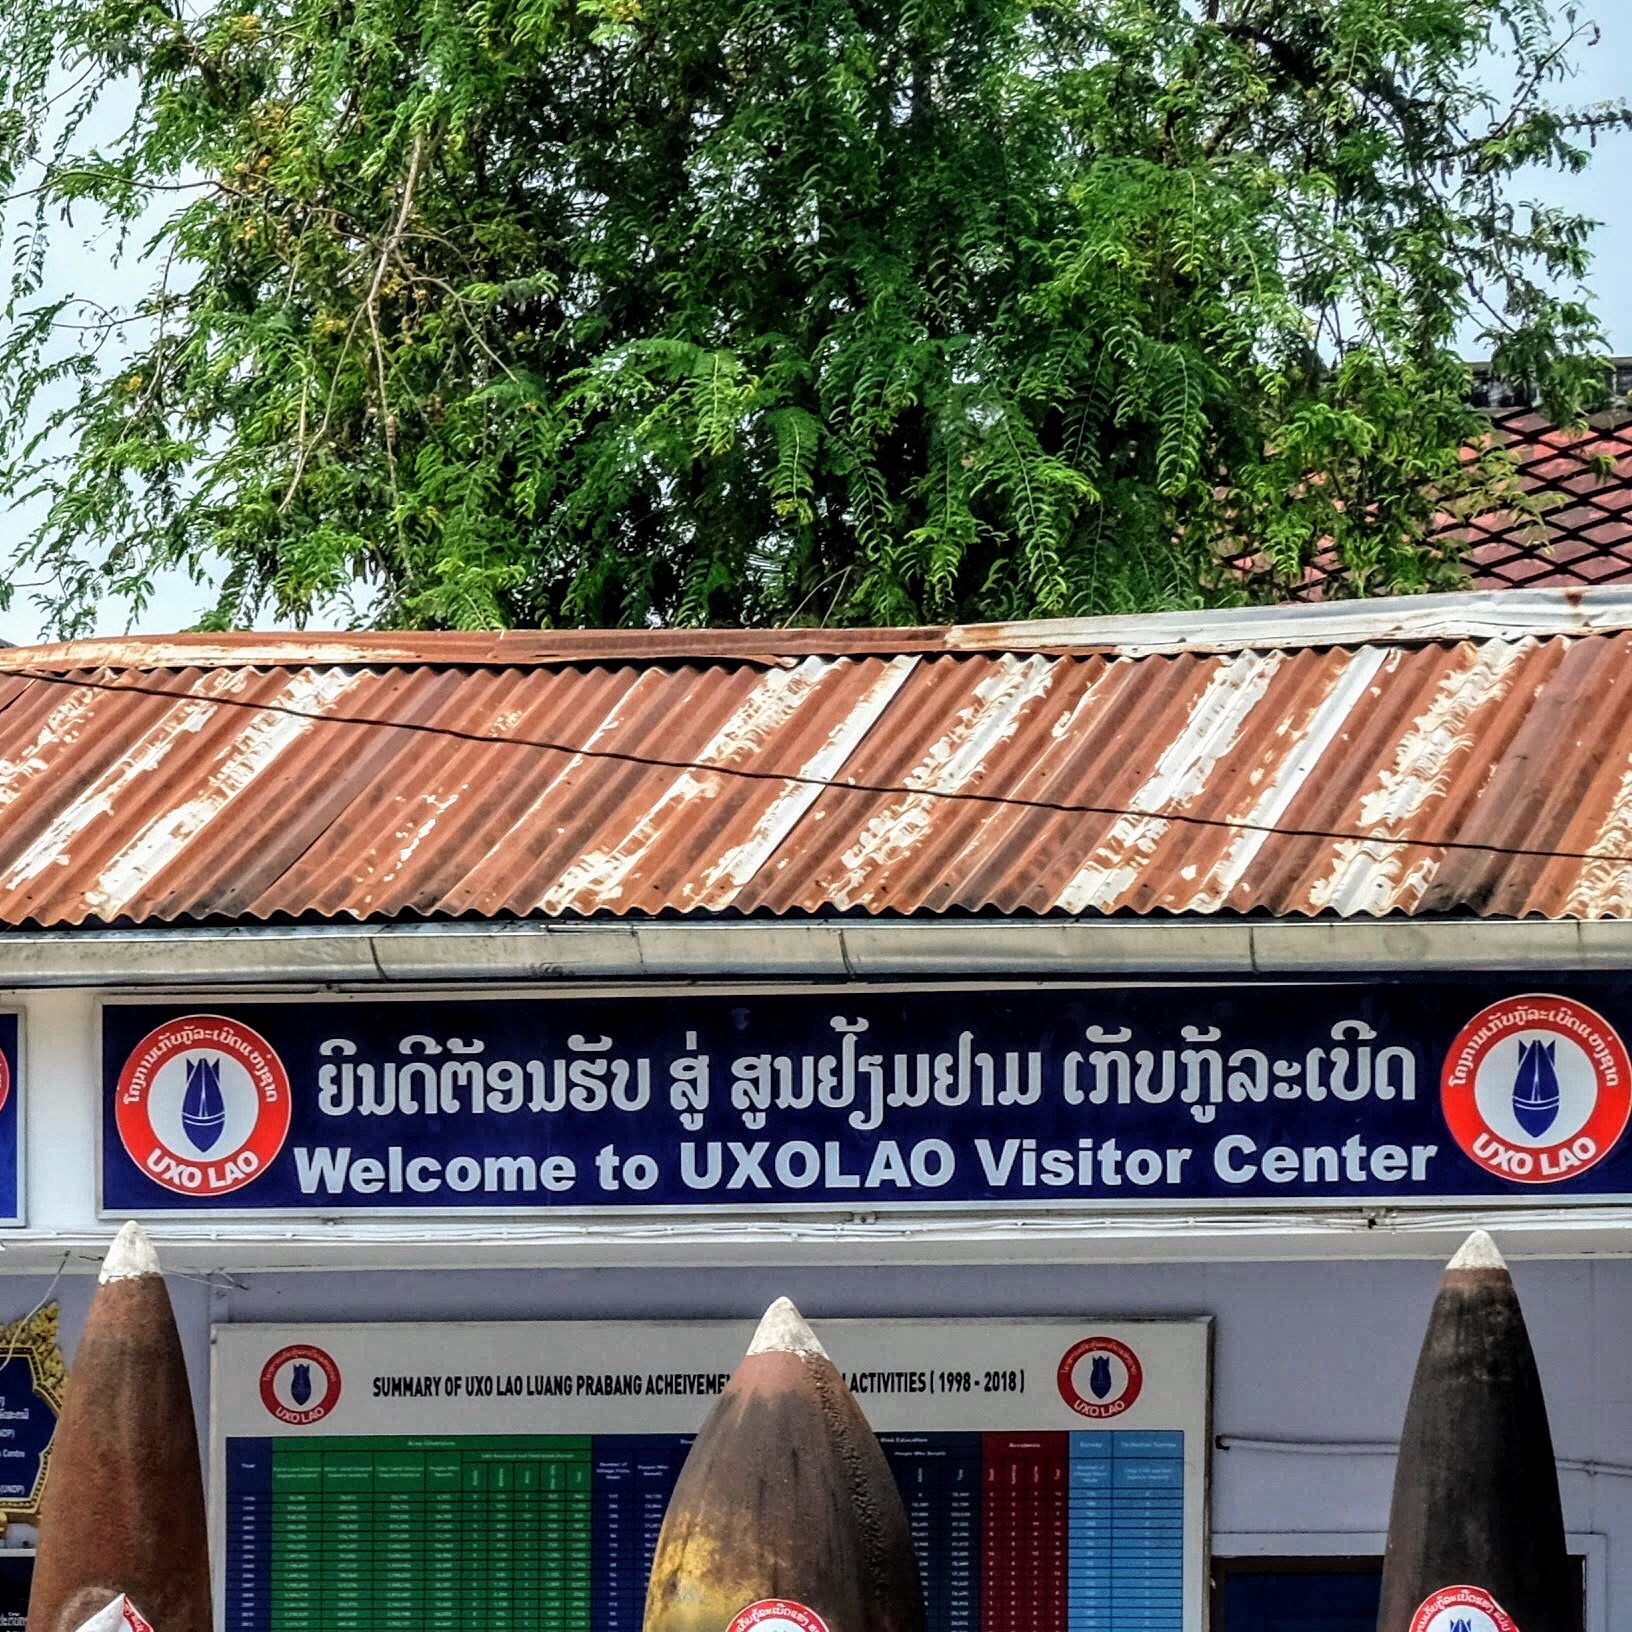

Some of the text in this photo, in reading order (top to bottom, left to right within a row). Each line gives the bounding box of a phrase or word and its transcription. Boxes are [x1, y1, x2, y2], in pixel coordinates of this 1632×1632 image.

[146, 1148, 260, 1188] UXO LAO
[294, 1134, 1438, 1194] Welcome to UXOLAO Visitor Center
[1472, 1133, 1596, 1175] UXO LAO
[373, 1376, 442, 1397] SUMMARY
[444, 1376, 463, 1397] OF
[465, 1376, 494, 1397] UXO
[496, 1375, 524, 1396] LAO
[526, 1375, 574, 1396] LUANG
[576, 1375, 643, 1396] PRABANG
[849, 1372, 927, 1393] ACTIVITIES
[938, 1371, 972, 1393] 1998
[983, 1371, 1017, 1393] 2018
[275, 1407, 325, 1423] UXO LAO
[1073, 1400, 1125, 1416] UXO LAO
